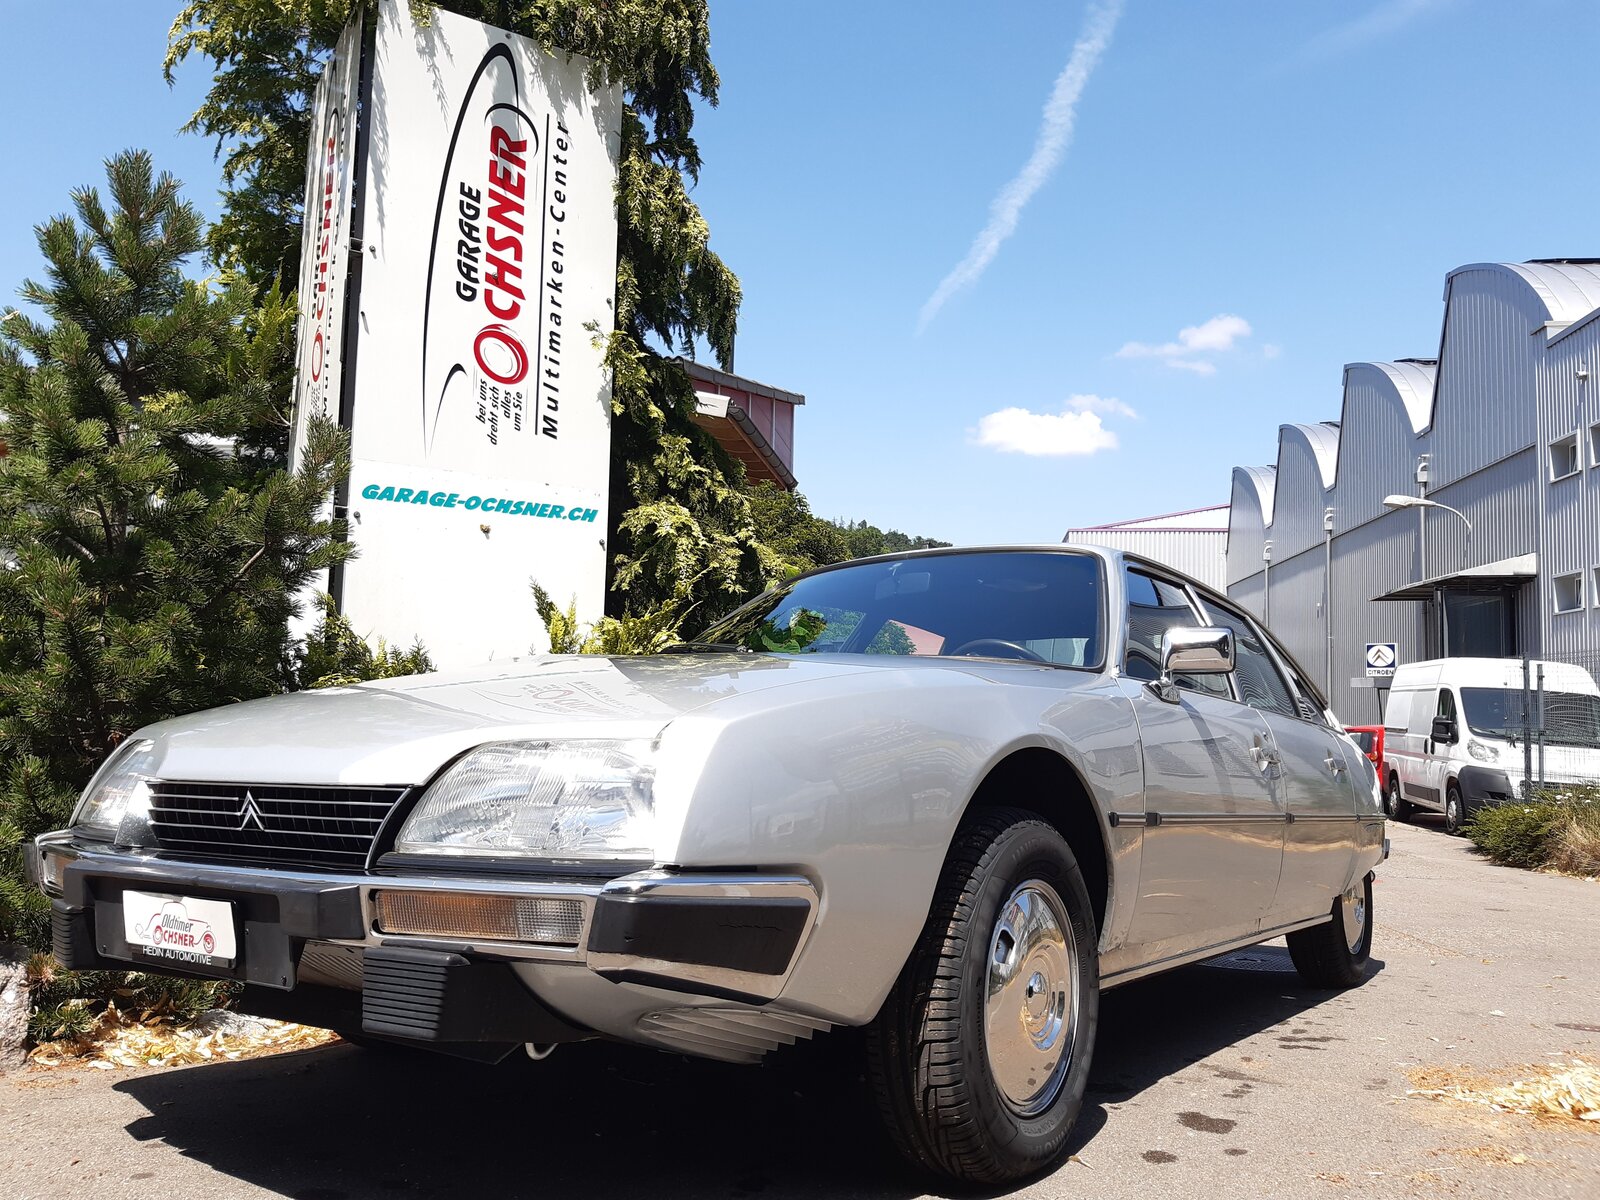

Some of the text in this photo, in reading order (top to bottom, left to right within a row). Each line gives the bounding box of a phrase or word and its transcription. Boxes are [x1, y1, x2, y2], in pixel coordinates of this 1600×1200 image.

[456, 182, 482, 302] GARAGE
[473, 125, 529, 385] OCHSNER
[542, 121, 570, 440] Multimarken-Center
[475, 378, 488, 424] bei uns
[487, 386, 500, 446] dreht sich
[500, 390, 512, 419] alles
[512, 391, 523, 432] um Sie
[361, 483, 599, 523] GARAGE-OCHSNER.CH
[153, 925, 195, 948] OCHSNER
[162, 914, 194, 933] Oldtimer
[143, 946, 212, 966] HEDIN AUTOMOTIVE
